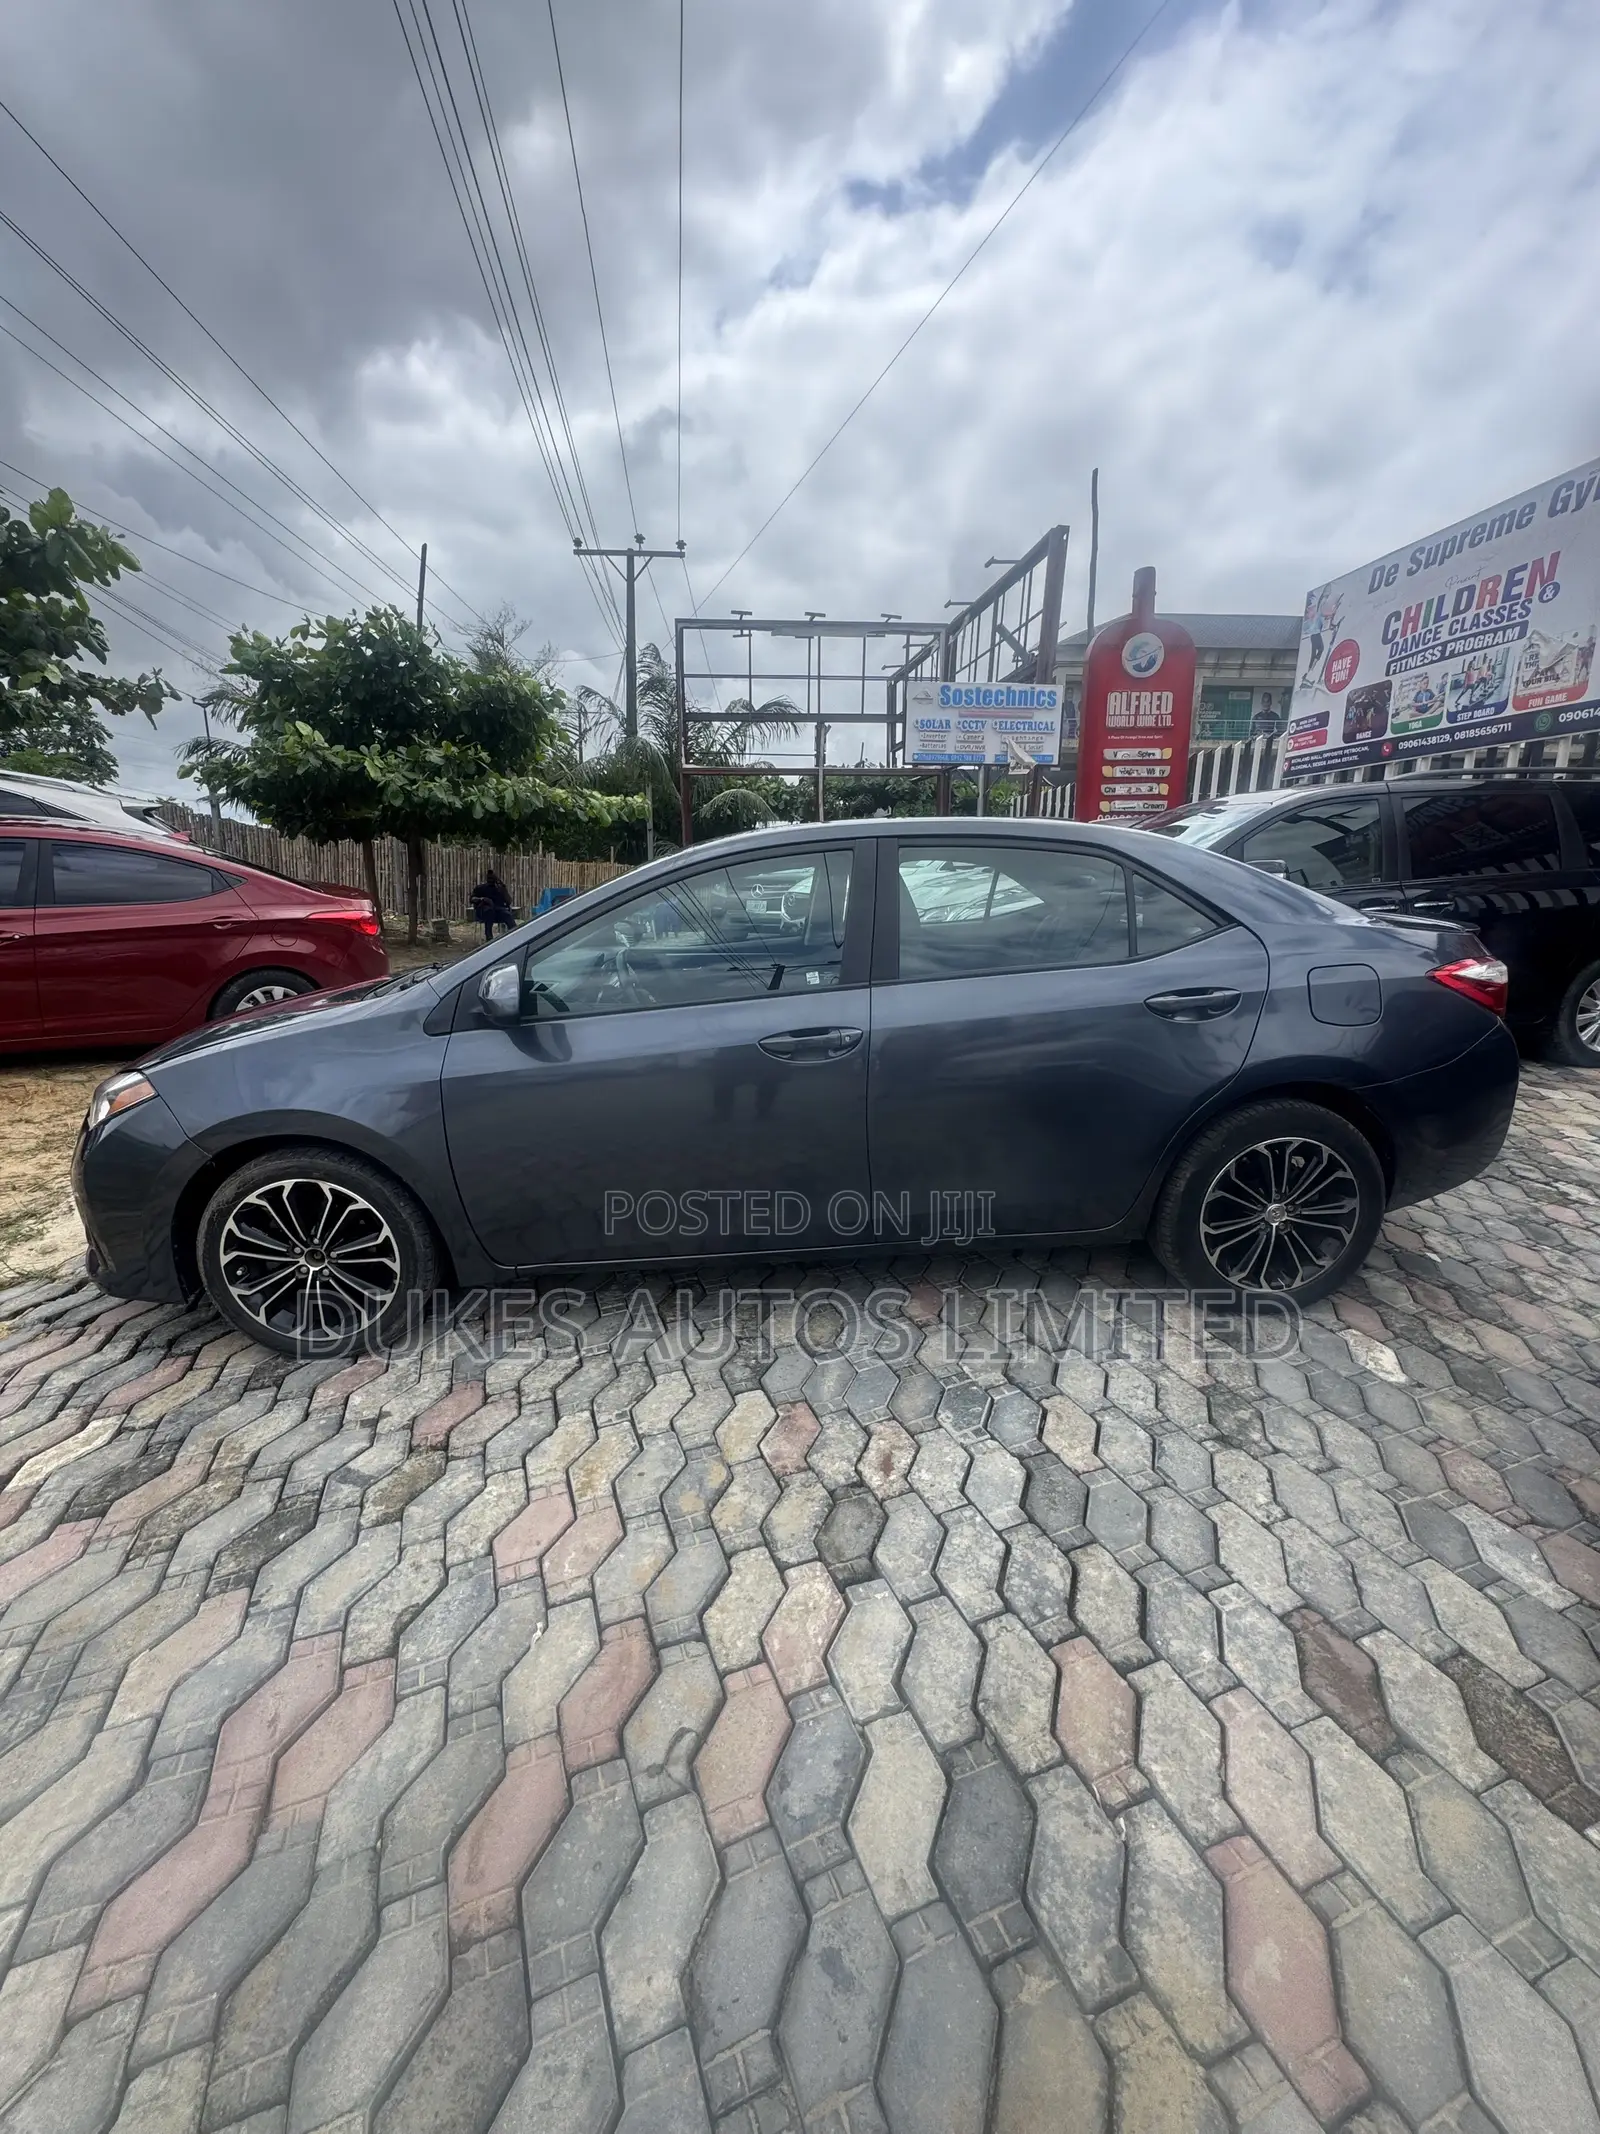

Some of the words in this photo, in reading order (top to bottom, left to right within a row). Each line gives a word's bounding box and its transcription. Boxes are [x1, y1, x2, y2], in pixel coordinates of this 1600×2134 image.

[1368, 562, 1400, 595] De
[1406, 501, 1537, 577] Supreme
[1381, 550, 1561, 646] CHILDREN
[1389, 624, 1443, 660] DANCE
[1447, 598, 1532, 637] CLASSES
[1389, 645, 1442, 676] FITNESS
[1445, 626, 1521, 657] PROGRAM
[1332, 655, 1353, 673] HAVE
[1330, 669, 1350, 685] FUN!
[940, 685, 1057, 708] Sostechnics
[1108, 691, 1174, 715] ALFRED
[1528, 696, 1543, 708] FUN
[1545, 693, 1568, 705] GAME
[1107, 715, 1135, 727] WORLD
[1136, 715, 1156, 727] WINE
[1457, 711, 1471, 722] STEP
[1473, 707, 1495, 718] BOARD
[1454, 722, 1512, 741] 08185656711
